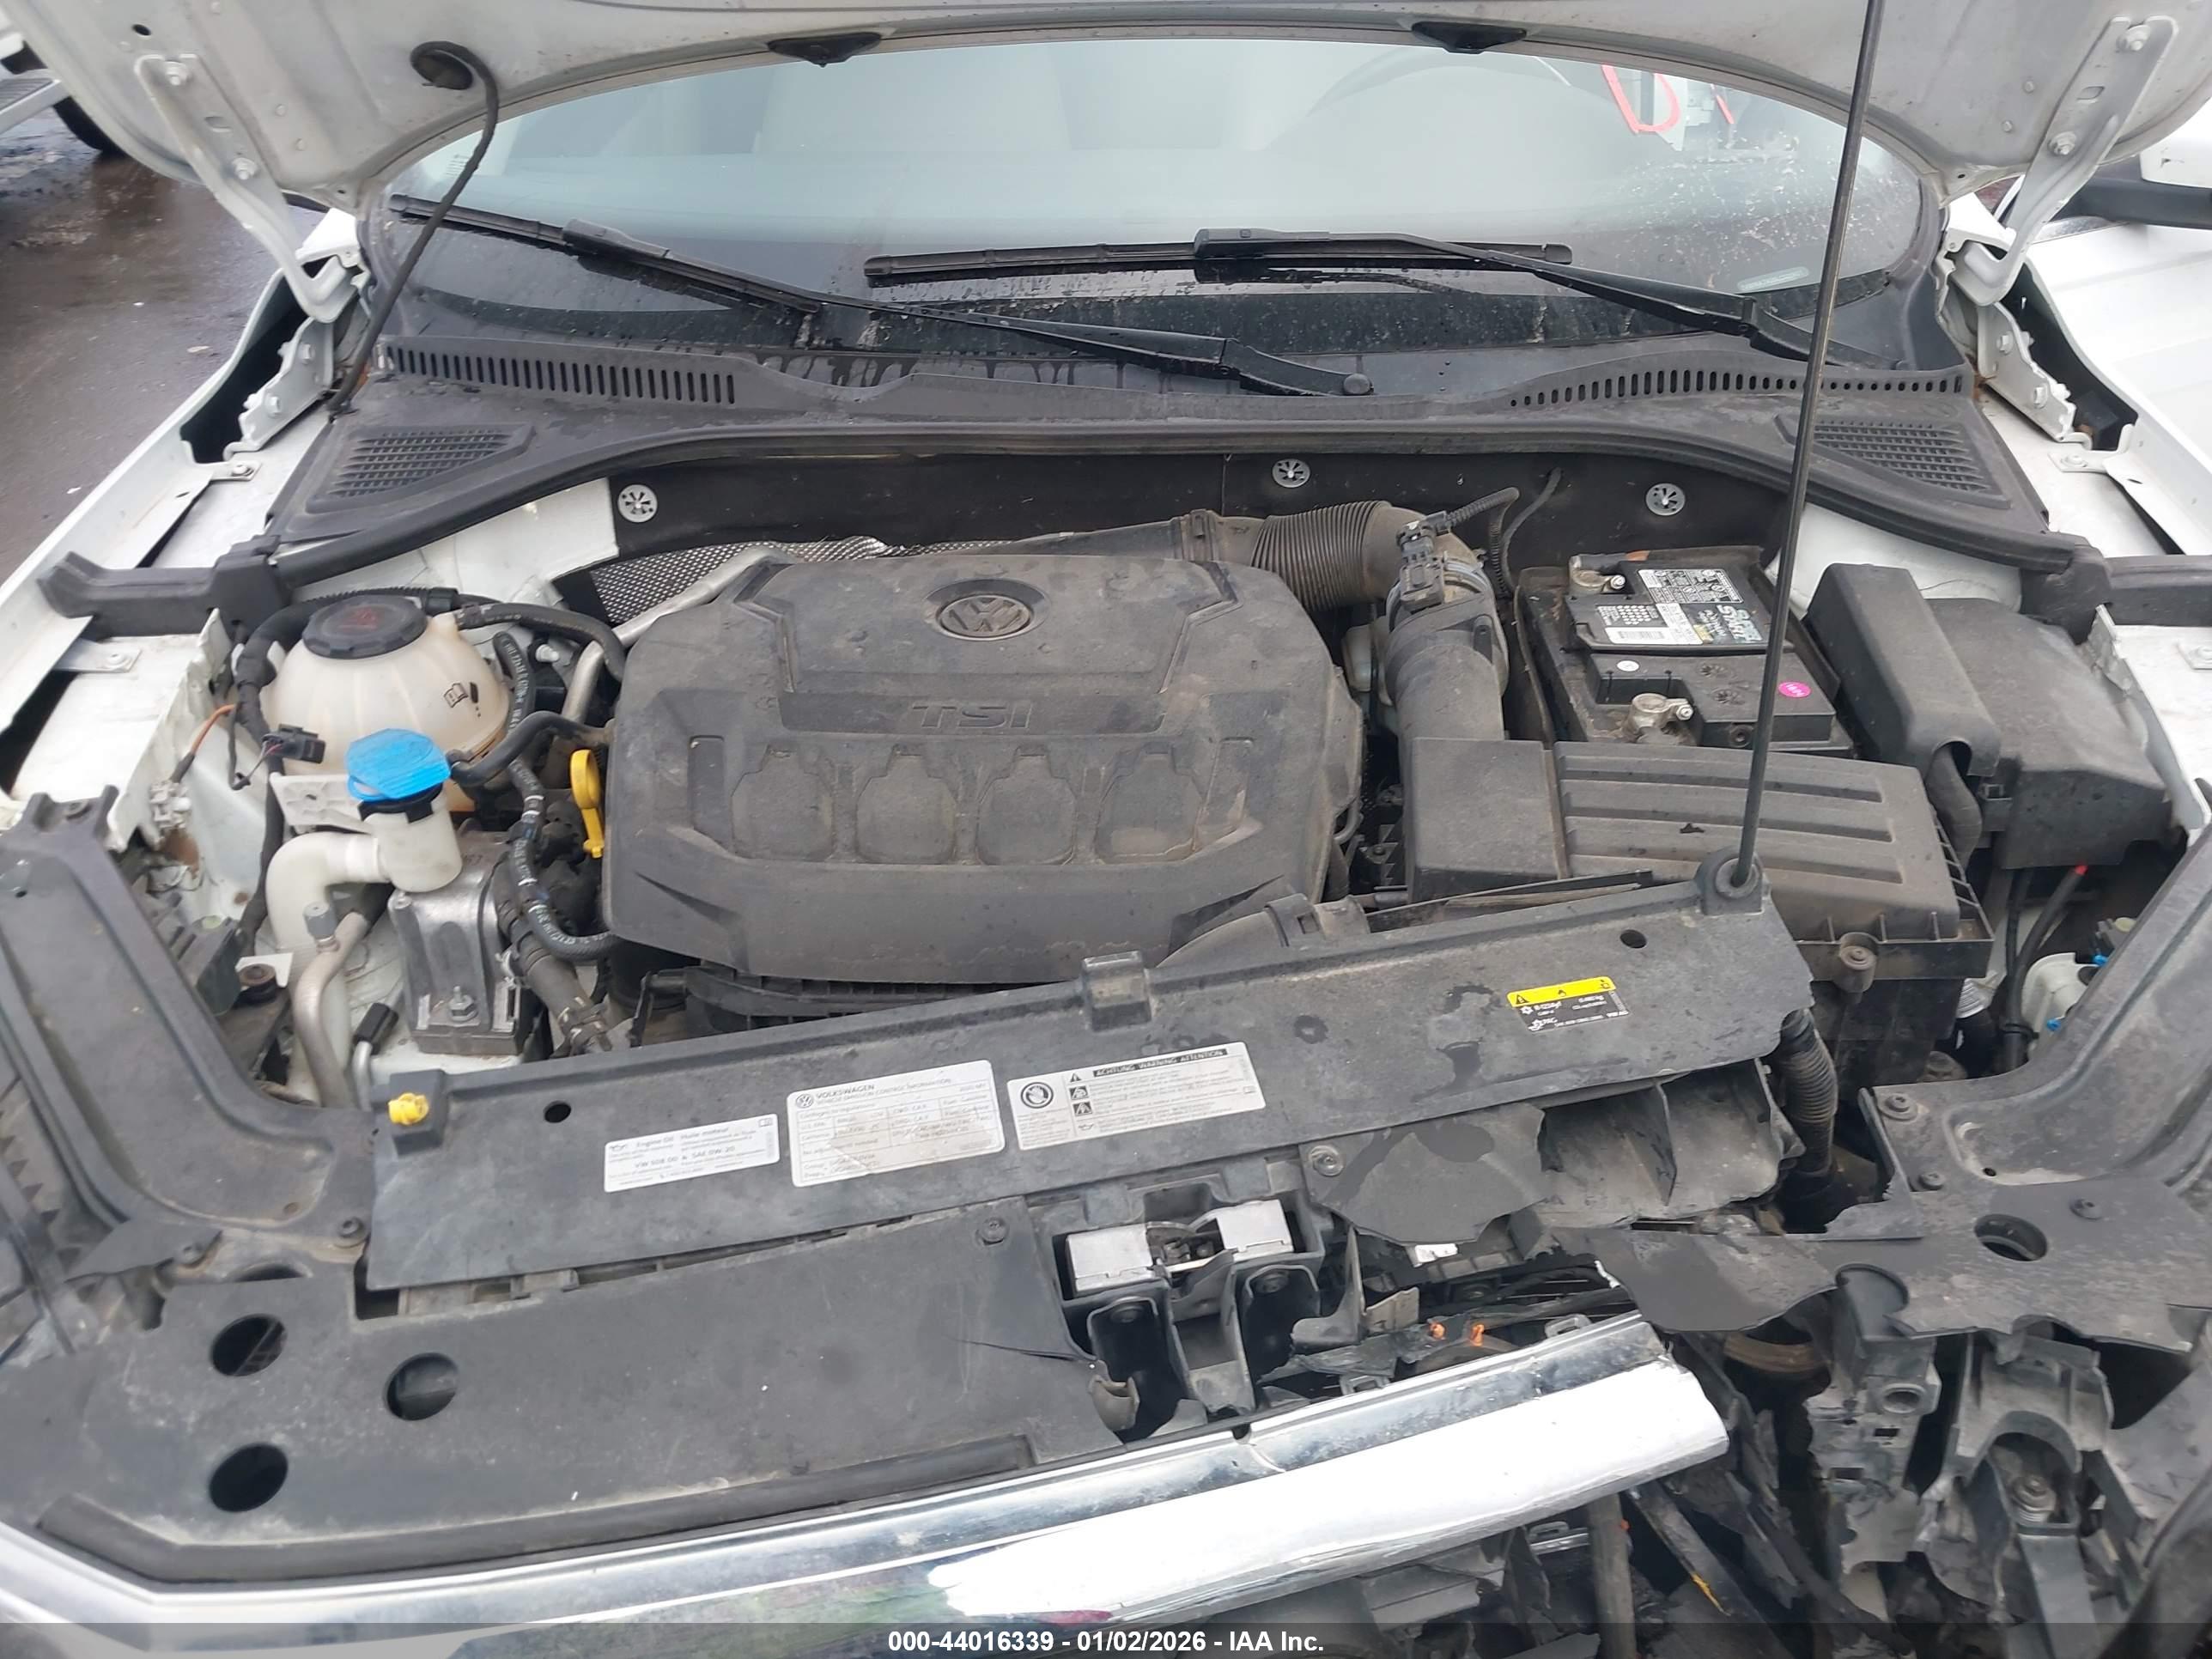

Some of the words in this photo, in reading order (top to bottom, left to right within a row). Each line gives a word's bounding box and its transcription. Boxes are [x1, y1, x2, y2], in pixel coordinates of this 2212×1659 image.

[912, 702, 1032, 728] TSI
[1096, 1064, 1135, 1076] ACHTUNG
[1139, 1057, 1176, 1068] WARNING
[1179, 1048, 1223, 1061] ATTENTION
[816, 1083, 874, 1098] VOLKSWAGEN
